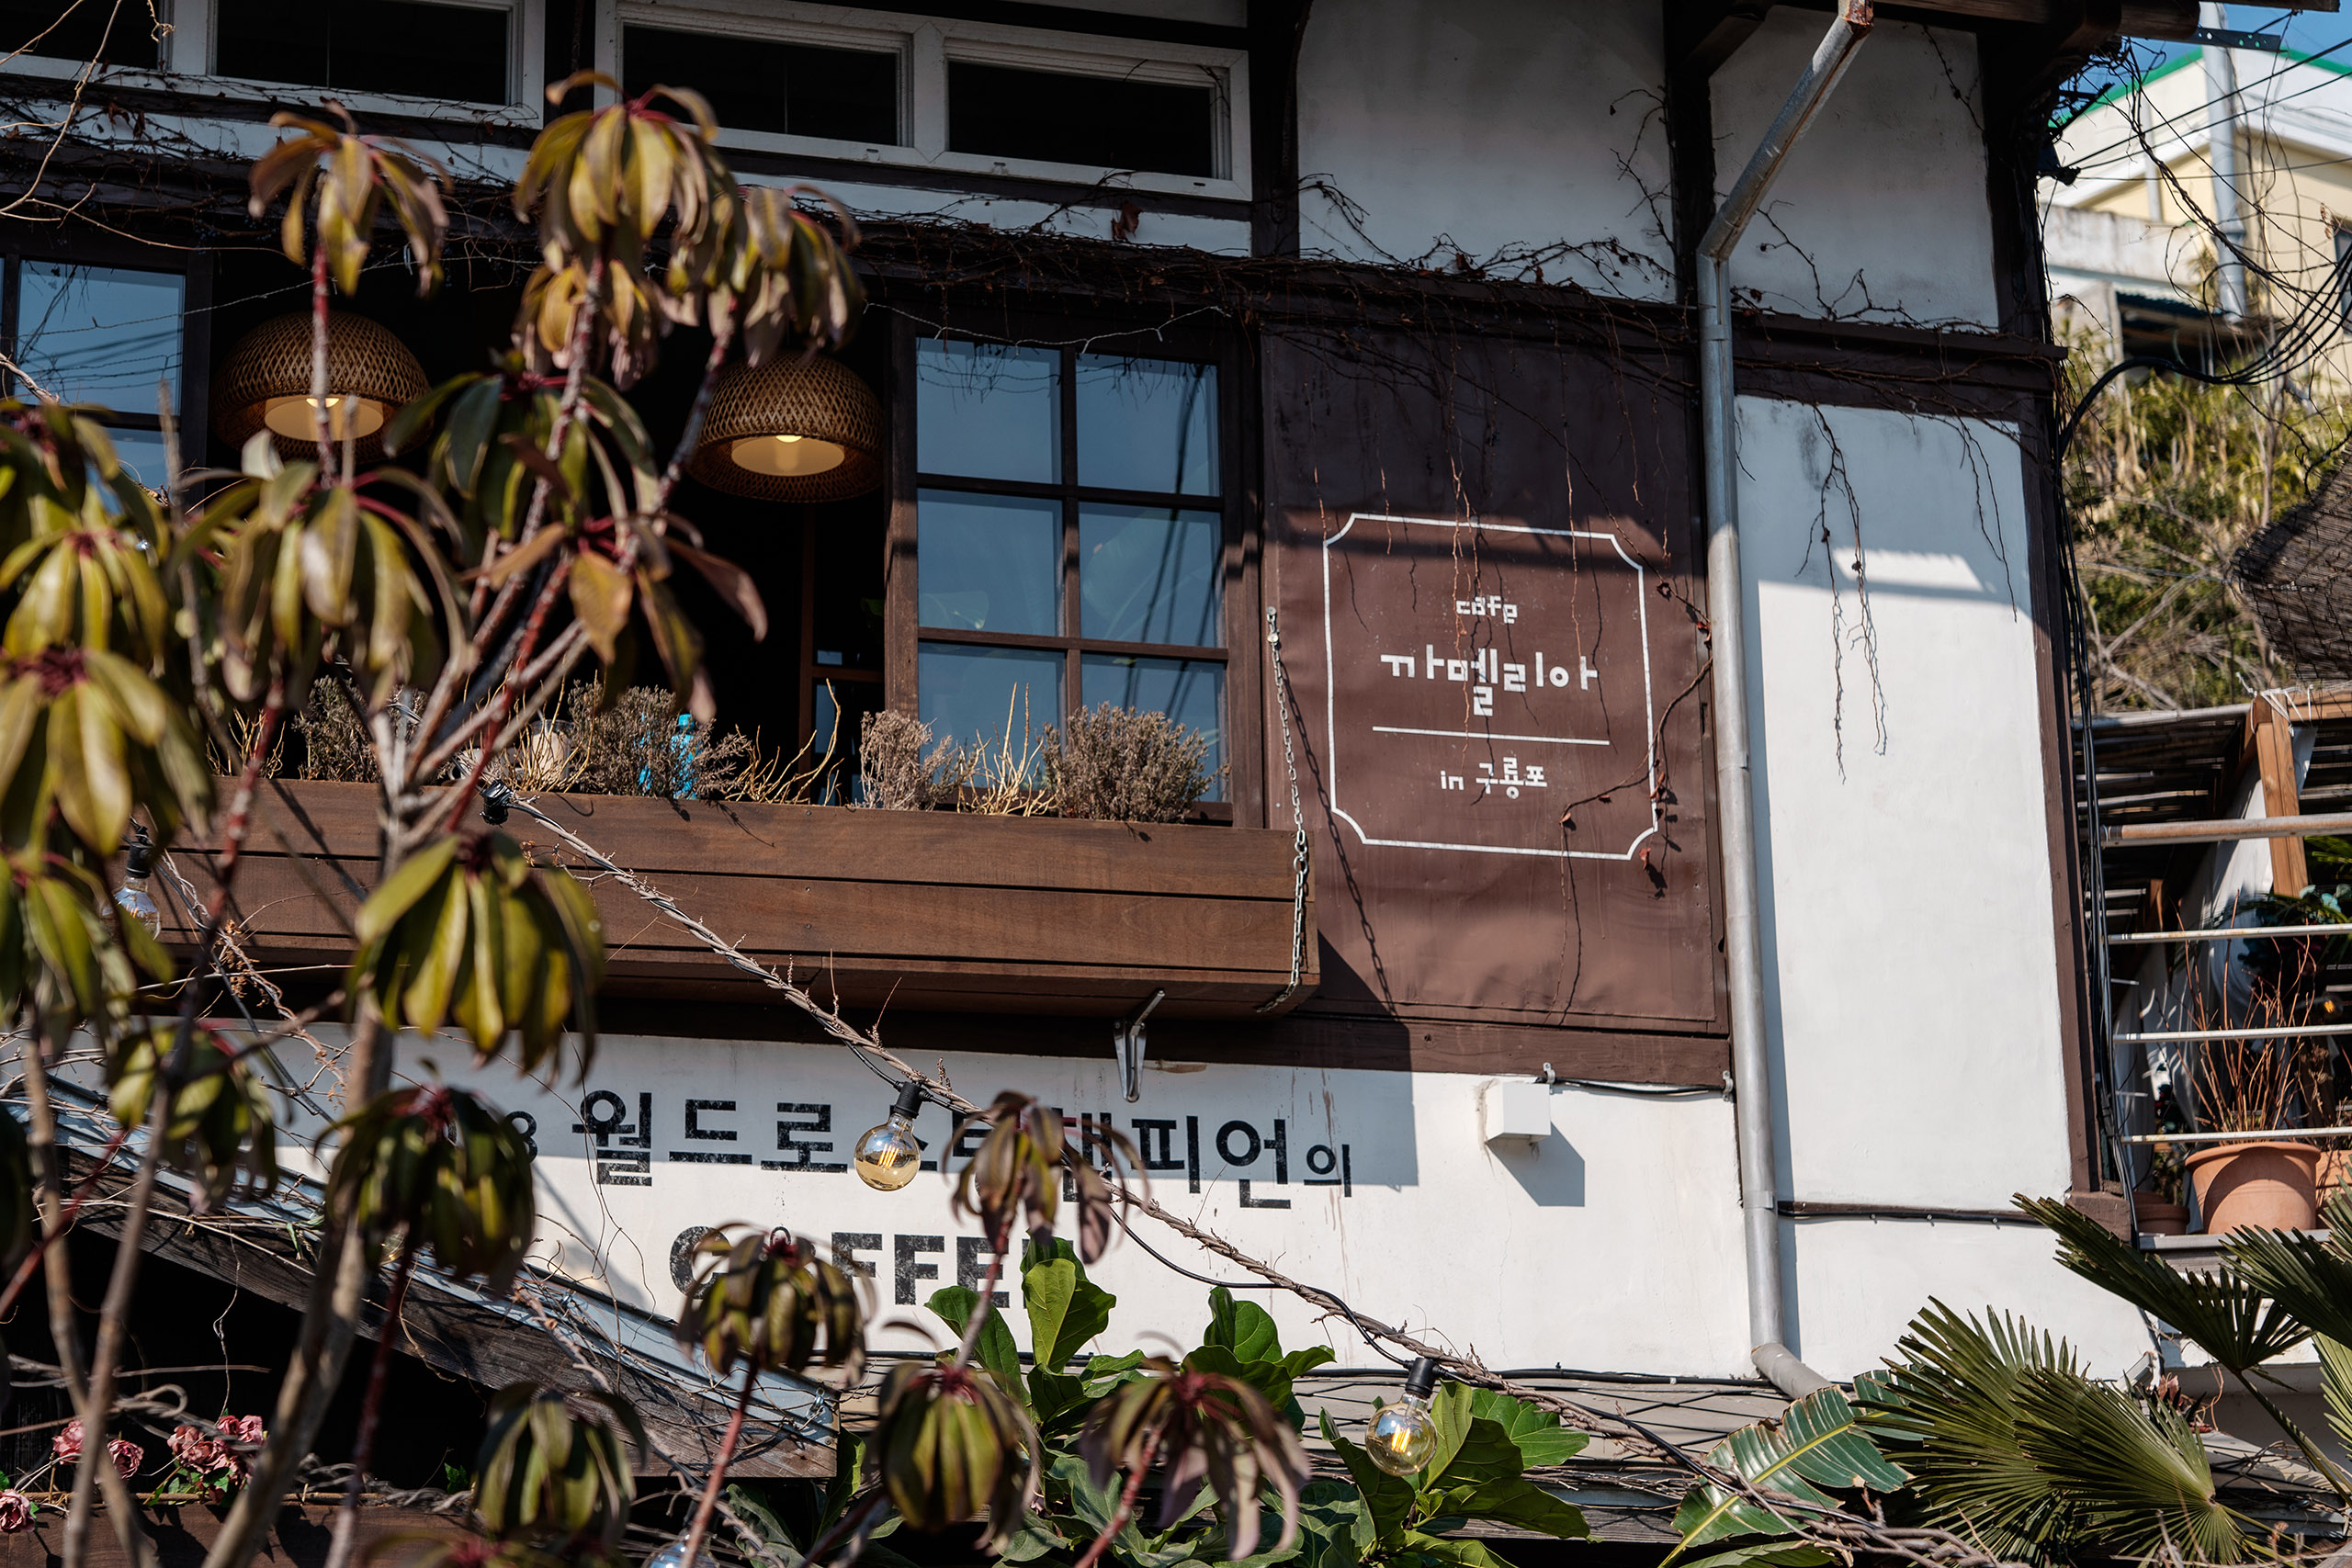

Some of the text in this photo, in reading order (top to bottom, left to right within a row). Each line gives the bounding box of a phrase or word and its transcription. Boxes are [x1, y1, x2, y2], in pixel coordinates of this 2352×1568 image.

[1456, 595, 1518, 625] cafe
[1380, 643, 1599, 716] 까멜리아
[1440, 756, 1548, 800] in 구룡포
[571, 1089, 1352, 1209] 월드로피언의
[669, 1225, 1074, 1309] CFFE
